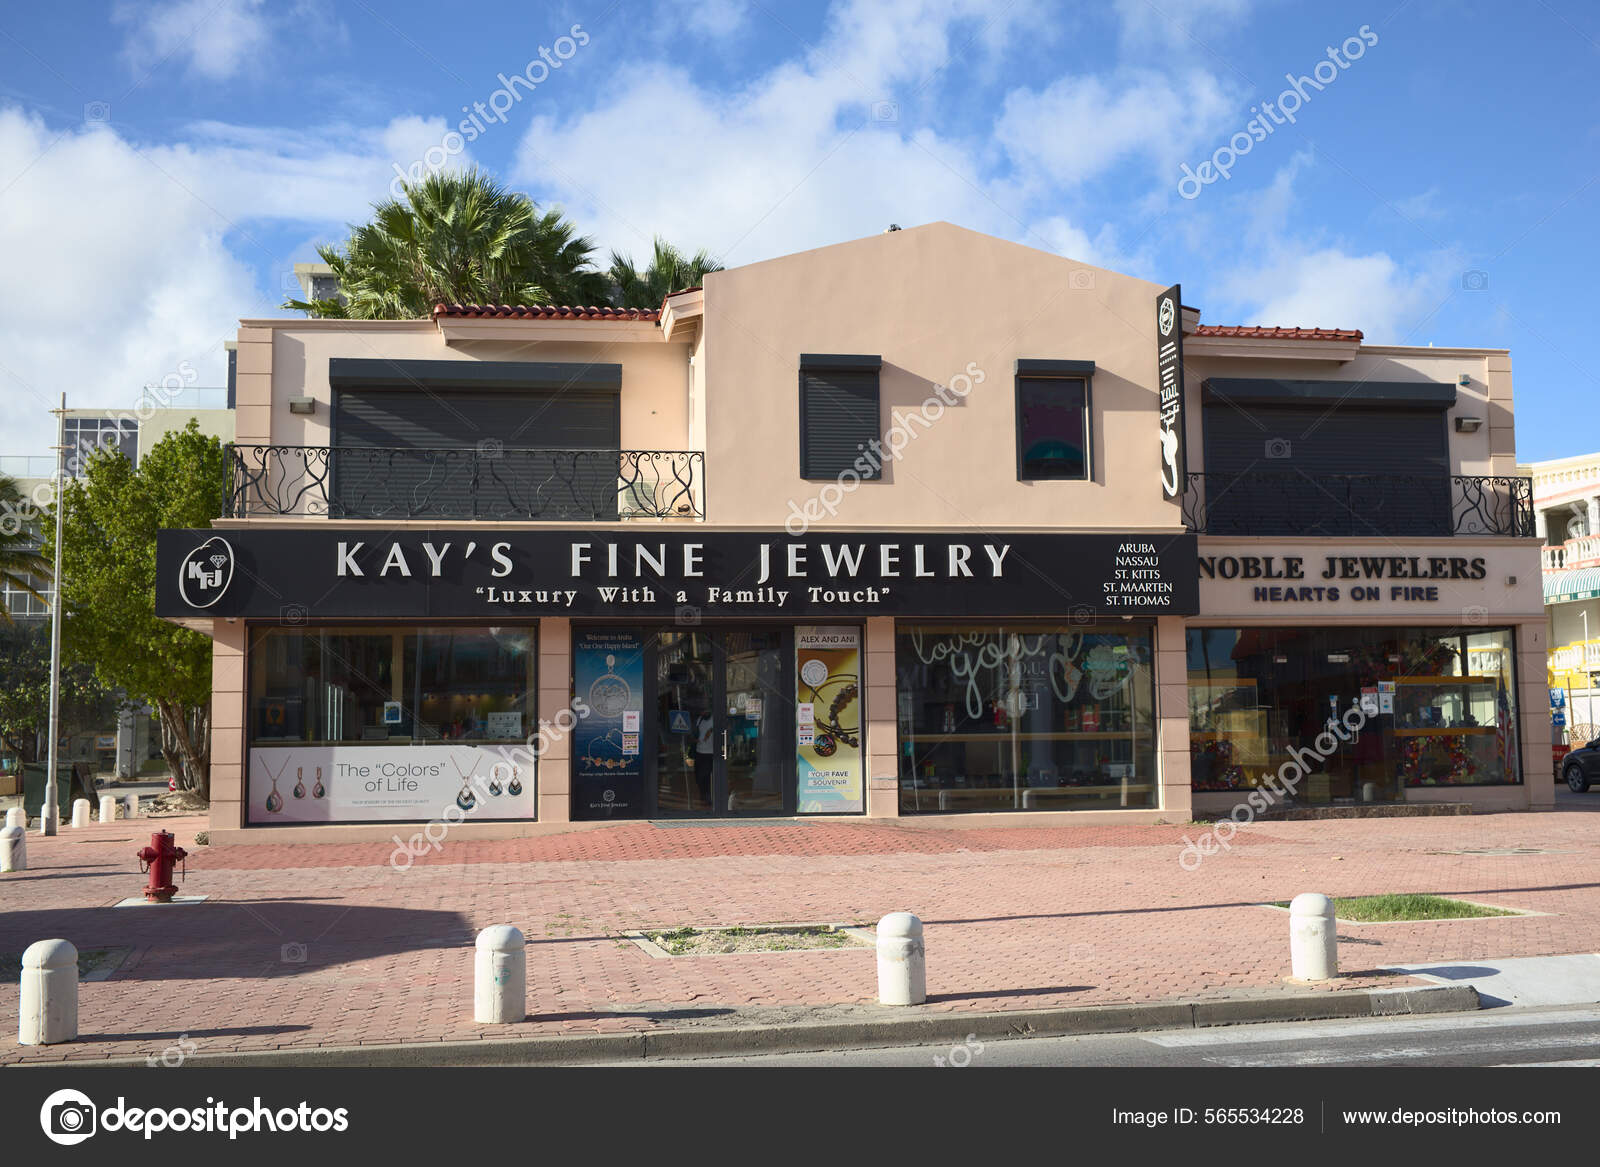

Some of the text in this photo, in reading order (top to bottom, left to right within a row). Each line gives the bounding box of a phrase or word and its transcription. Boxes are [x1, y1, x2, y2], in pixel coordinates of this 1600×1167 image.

[1118, 543, 1156, 553] ARUBA
[571, 543, 704, 577] FINE
[757, 543, 1011, 584] JEWELRY
[1115, 556, 1159, 566] NASSAU
[1197, 556, 1487, 580] NOBLE JEWELERS
[1114, 569, 1161, 579] ST. KITTS
[1103, 582, 1173, 592] ST. MAARTEN
[597, 587, 656, 603] With
[676, 590, 688, 603] a
[707, 586, 789, 607] Family
[1253, 586, 1439, 602] HEARTS ON FIRE
[1106, 595, 1171, 606] ST. THOMAS
[801, 635, 855, 643] ALEX AND ANI
[336, 763, 371, 777] The
[831, 770, 849, 778] FAVE
[364, 777, 419, 792] of Life
